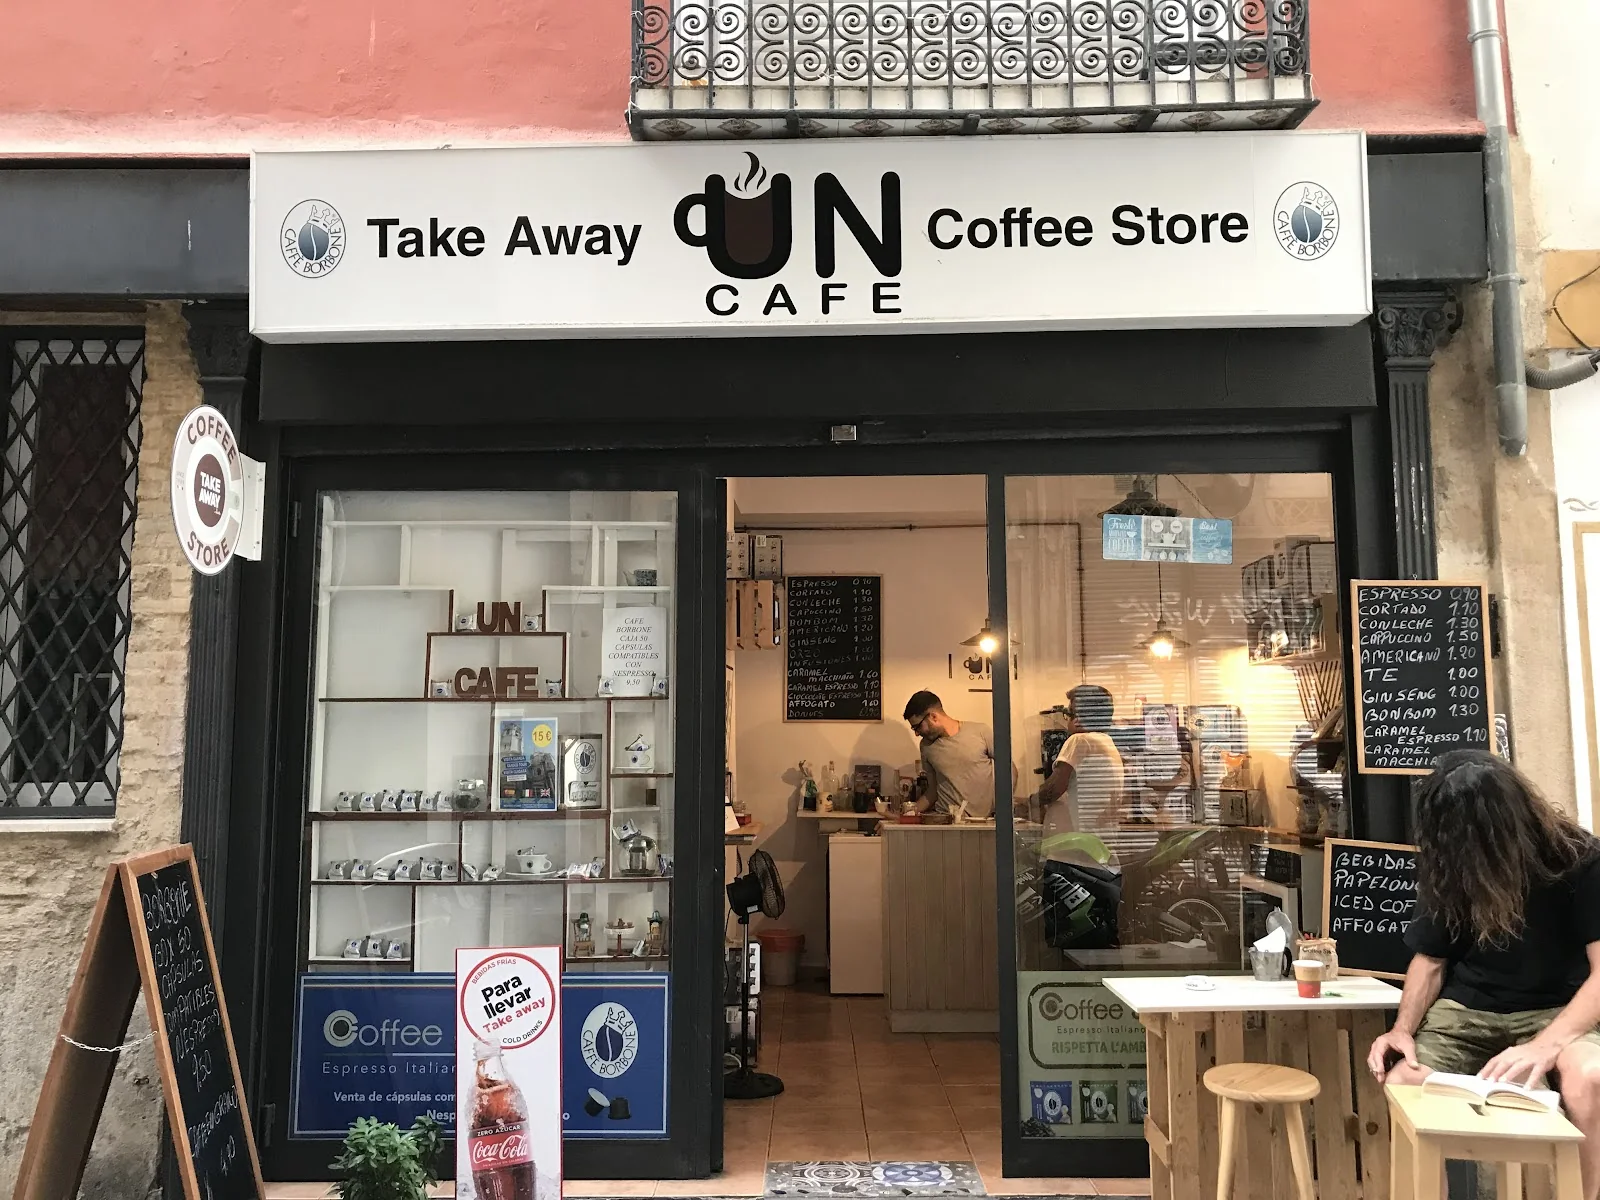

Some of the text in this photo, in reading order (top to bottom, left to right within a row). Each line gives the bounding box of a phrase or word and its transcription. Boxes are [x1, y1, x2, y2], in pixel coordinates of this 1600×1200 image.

[674, 170, 902, 280] UN
[926, 204, 1249, 250] Coffee Store
[1297, 208, 1336, 257] BORBONE
[366, 214, 642, 266] Take Away
[302, 227, 341, 275] BORBONE
[705, 282, 903, 316] CAFE
[187, 415, 237, 464] COFFEE
[200, 471, 221, 490] TAKE
[199, 487, 221, 510] AWAY
[187, 531, 230, 566] STORE
[1359, 587, 1442, 602] ESPRESSO
[476, 601, 521, 632] UN
[1359, 602, 1427, 616] CORTADO
[1361, 647, 1441, 664] AMERICANO
[454, 666, 539, 699] CAFE
[1364, 667, 1399, 682] TE
[788, 699, 836, 708] AFFOGATO
[533, 731, 544, 742] 15
[1363, 725, 1426, 738] CARAMEL
[1397, 732, 1460, 745] ESPRESSO
[1364, 744, 1431, 756] CARAMEL
[1375, 755, 1442, 767] MACCHIA
[1335, 852, 1416, 870] BEBIDAS
[1334, 894, 1418, 914] ICED COF
[1333, 917, 1412, 933] AFFOGAT
[471, 961, 497, 985] BEBIDAS
[481, 975, 523, 1003] Para
[483, 986, 532, 1019] llevar
[1038, 992, 1124, 1021] Coffee
[482, 996, 546, 1033] Take away
[323, 1009, 442, 1047] Coffee
[502, 1019, 543, 1044] COLD DRINKS
[1057, 1025, 1102, 1035] Espresso
[599, 1029, 637, 1076] BORBONE
[1051, 1041, 1146, 1054] RISPETTA L'AMB
[322, 1061, 397, 1076] Espresso
[333, 1091, 366, 1102] Venta
[368, 1090, 383, 1102] de
[386, 1090, 432, 1104] cápsulas
[477, 1129, 494, 1137] ZERO
